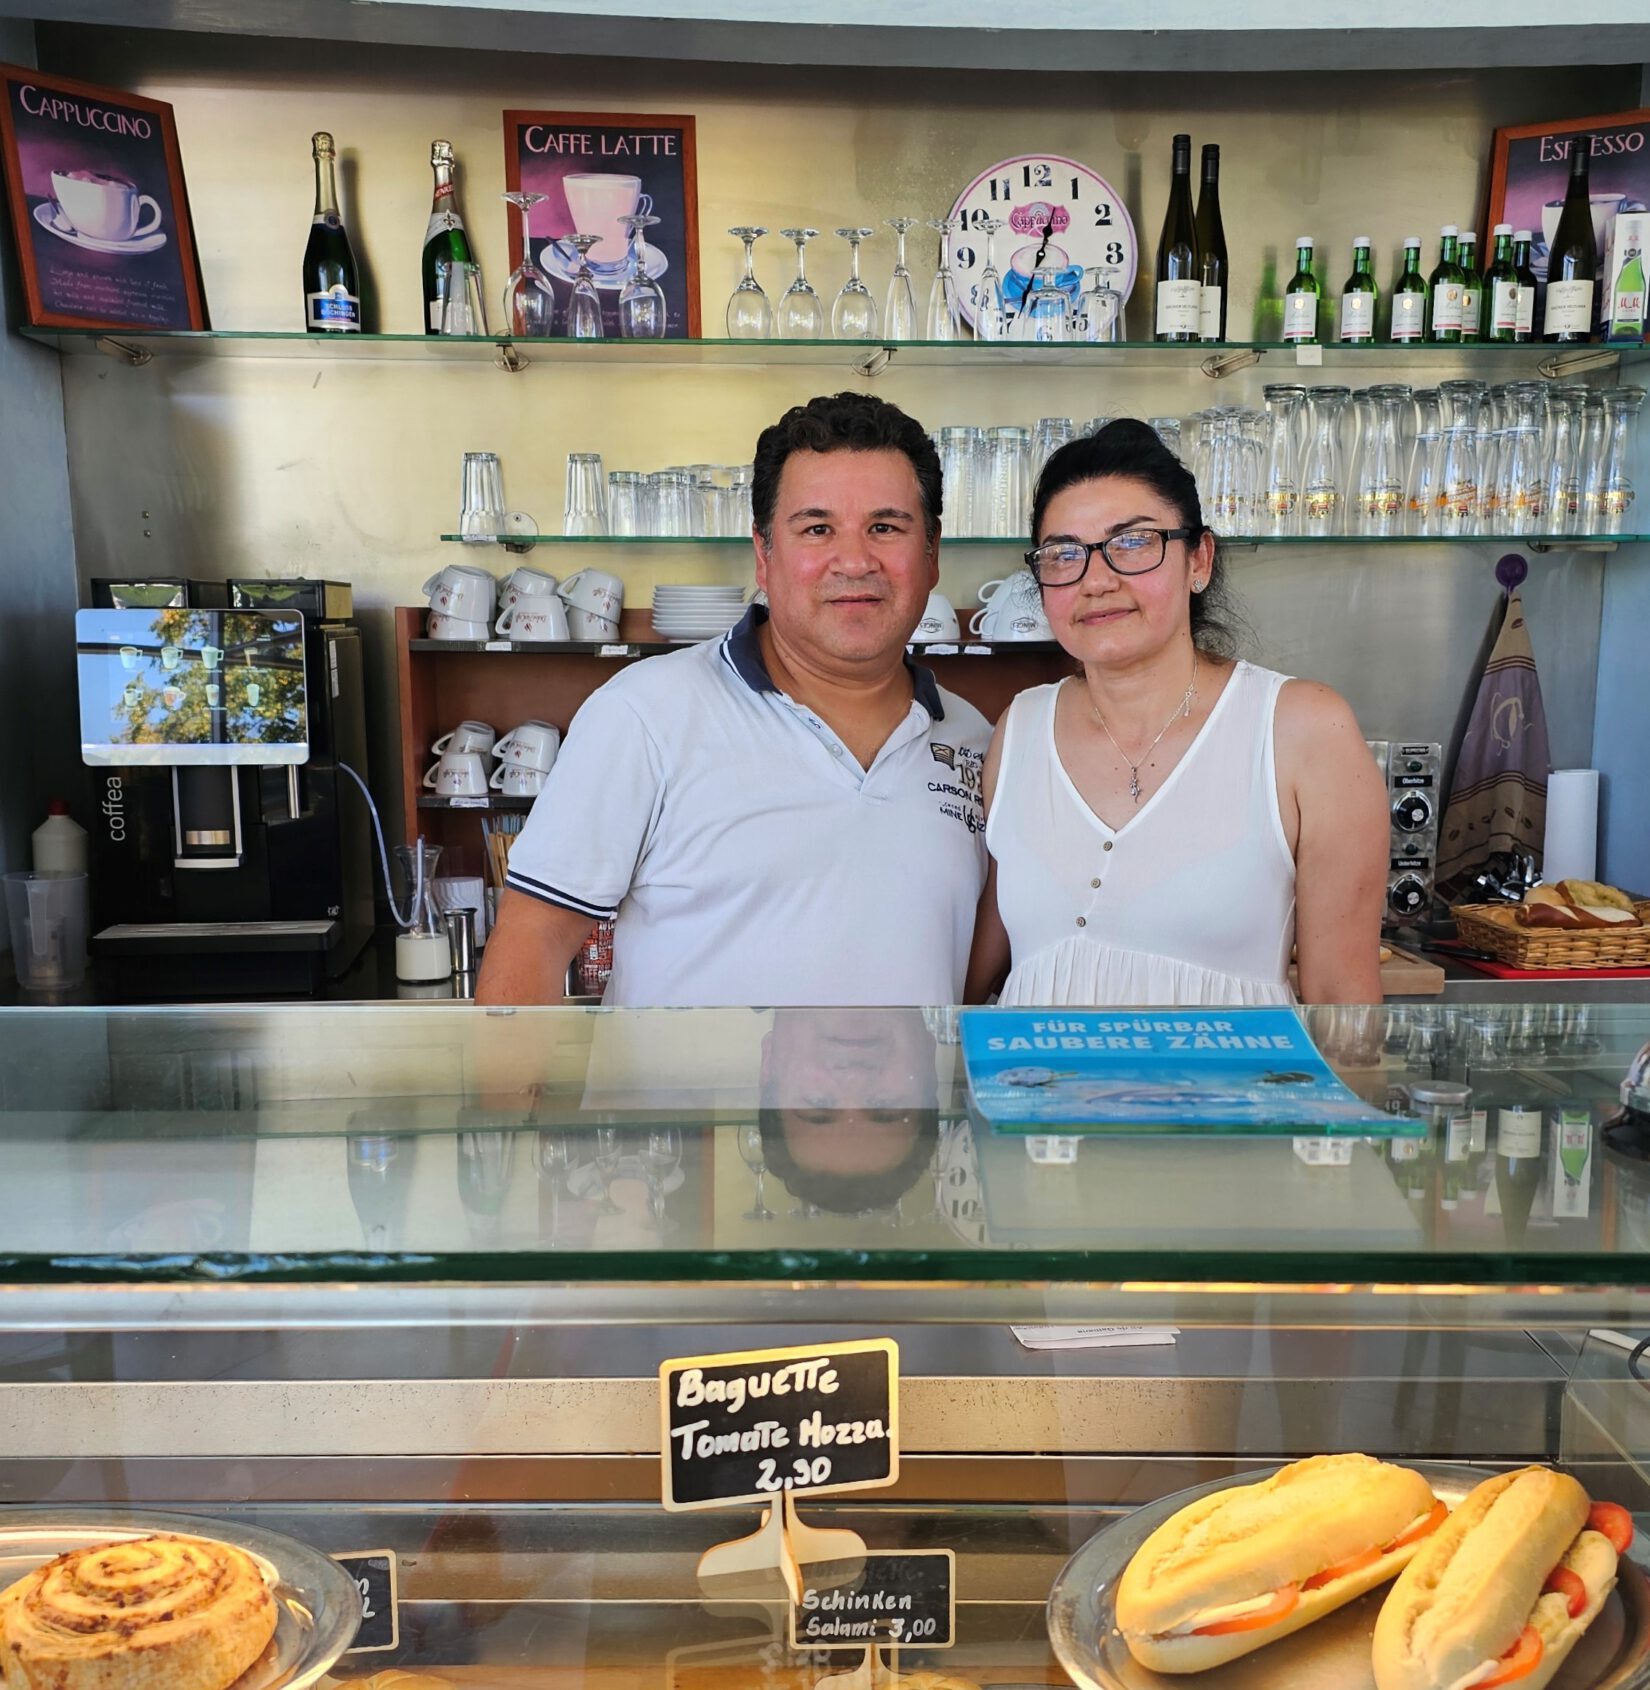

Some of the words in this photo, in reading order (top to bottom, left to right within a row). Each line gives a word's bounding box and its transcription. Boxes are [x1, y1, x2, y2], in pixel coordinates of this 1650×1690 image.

[19, 85, 151, 139] CAPPUCCINO
[524, 125, 593, 155] CAFFE
[601, 134, 677, 156] LATTE
[1539, 131, 1645, 162] ESPESSO
[1023, 164, 1052, 187] 12
[989, 178, 1011, 200] 11
[1070, 177, 1079, 200] 1
[1094, 203, 1112, 226] 2
[957, 246, 975, 269] 9
[1106, 241, 1124, 265] 3
[927, 782, 972, 800] CARSON
[102, 776, 126, 842] coffea
[1032, 1020, 1088, 1033] FÜR
[1100, 1020, 1235, 1033] SPÜRBAR
[987, 1037, 1153, 1051] SAUBERE
[1167, 1033, 1295, 1050] ZÄHNE
[671, 1419, 790, 1460] Tomate
[802, 1588, 912, 1611] Schinken
[805, 1615, 877, 1637] Salami
[888, 1617, 936, 1643] 3,00
